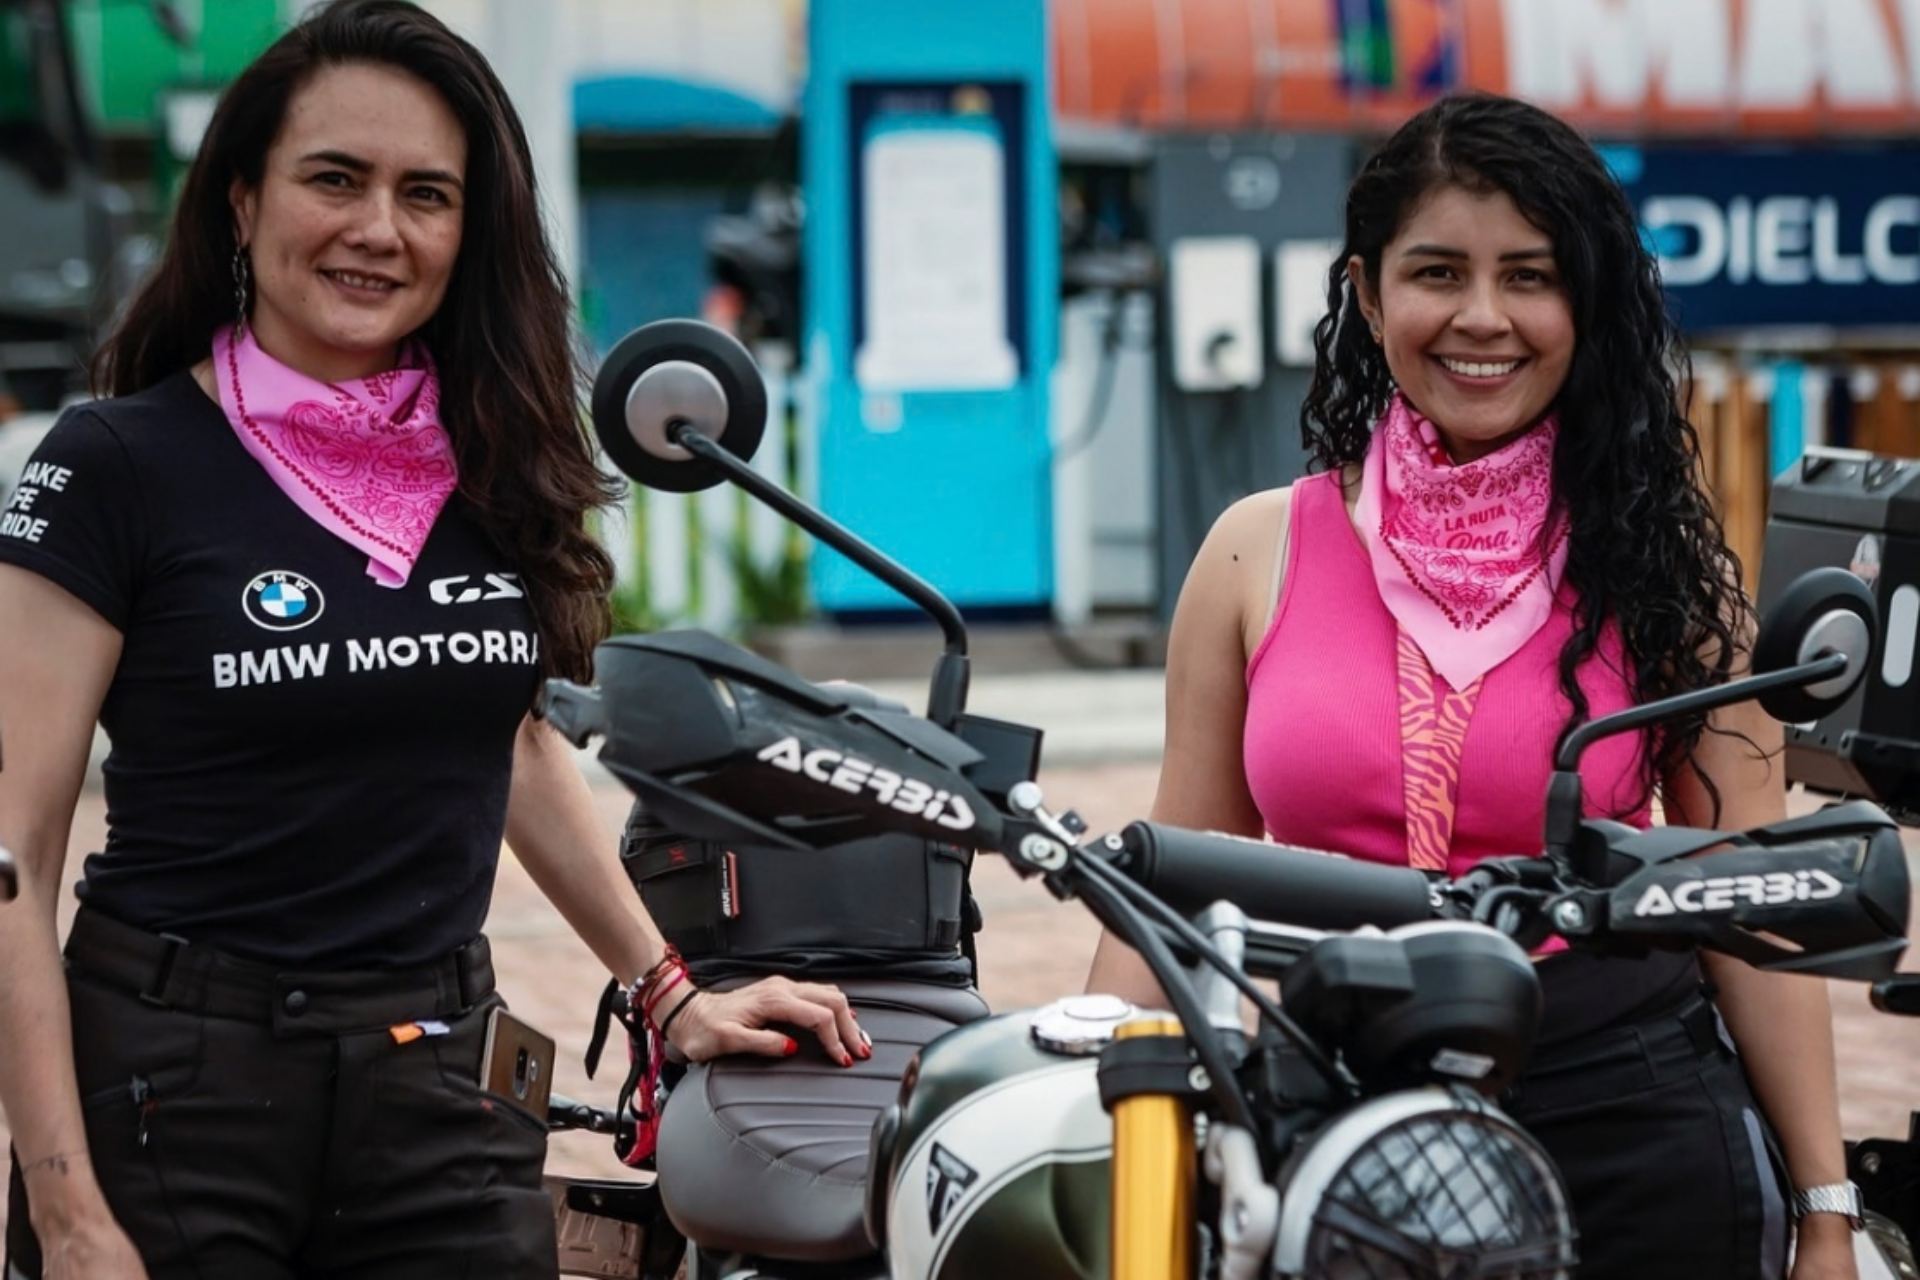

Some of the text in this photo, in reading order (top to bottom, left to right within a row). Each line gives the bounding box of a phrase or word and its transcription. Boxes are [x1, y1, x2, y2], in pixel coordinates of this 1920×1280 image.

[22, 461, 73, 492] AKE
[1444, 504, 1506, 532] LA RUTA
[428, 572, 524, 605] GS
[212, 642, 331, 689] BMW
[756, 735, 977, 831] ACERBIS
[1633, 868, 1844, 918] ACERBIS
